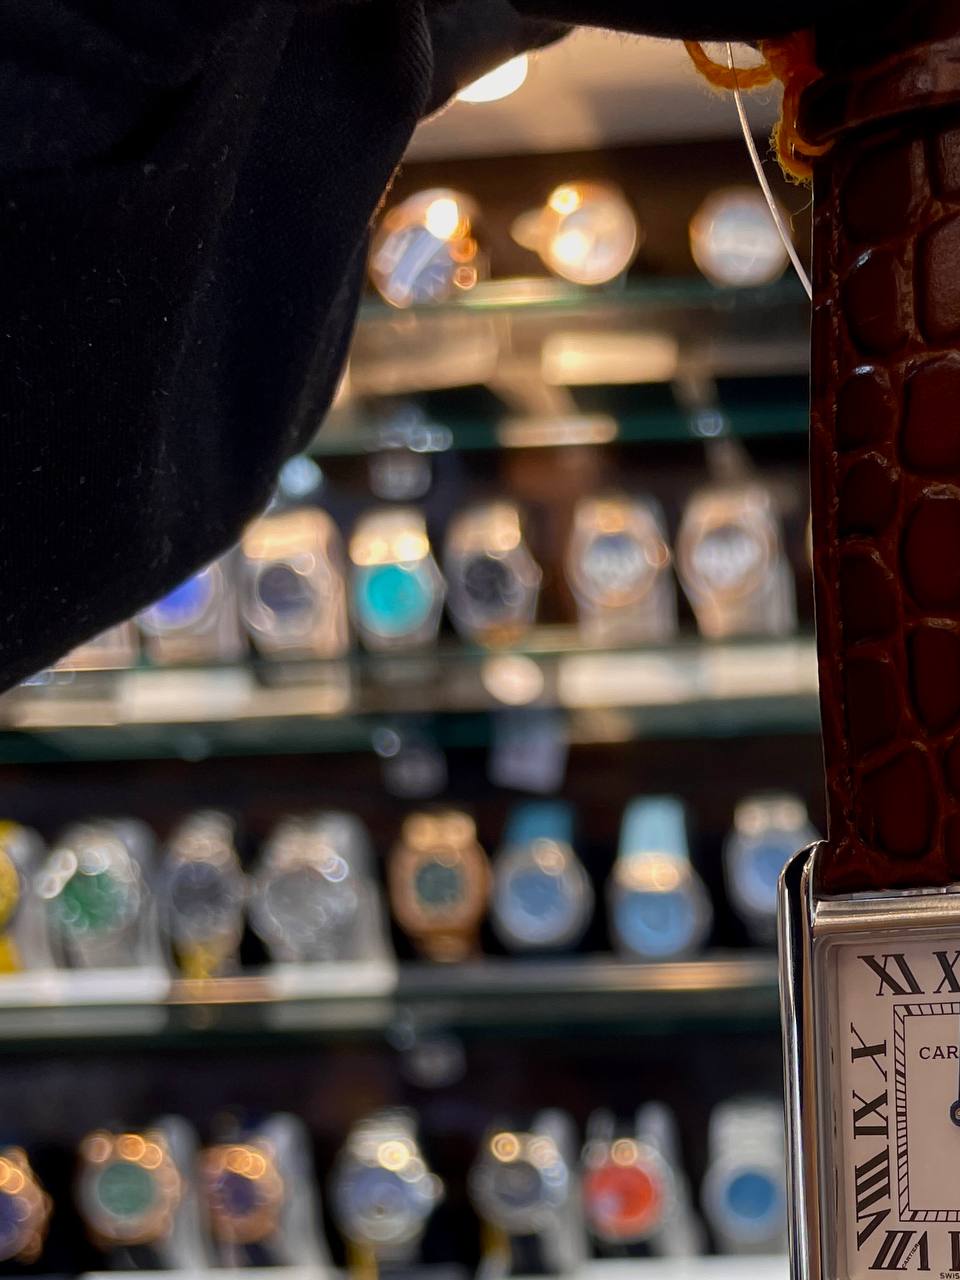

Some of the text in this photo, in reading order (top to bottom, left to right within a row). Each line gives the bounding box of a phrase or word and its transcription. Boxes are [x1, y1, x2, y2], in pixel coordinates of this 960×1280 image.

[858, 955, 925, 996] XI
[851, 1022, 887, 1082] X
[852, 1089, 889, 1140] IX
